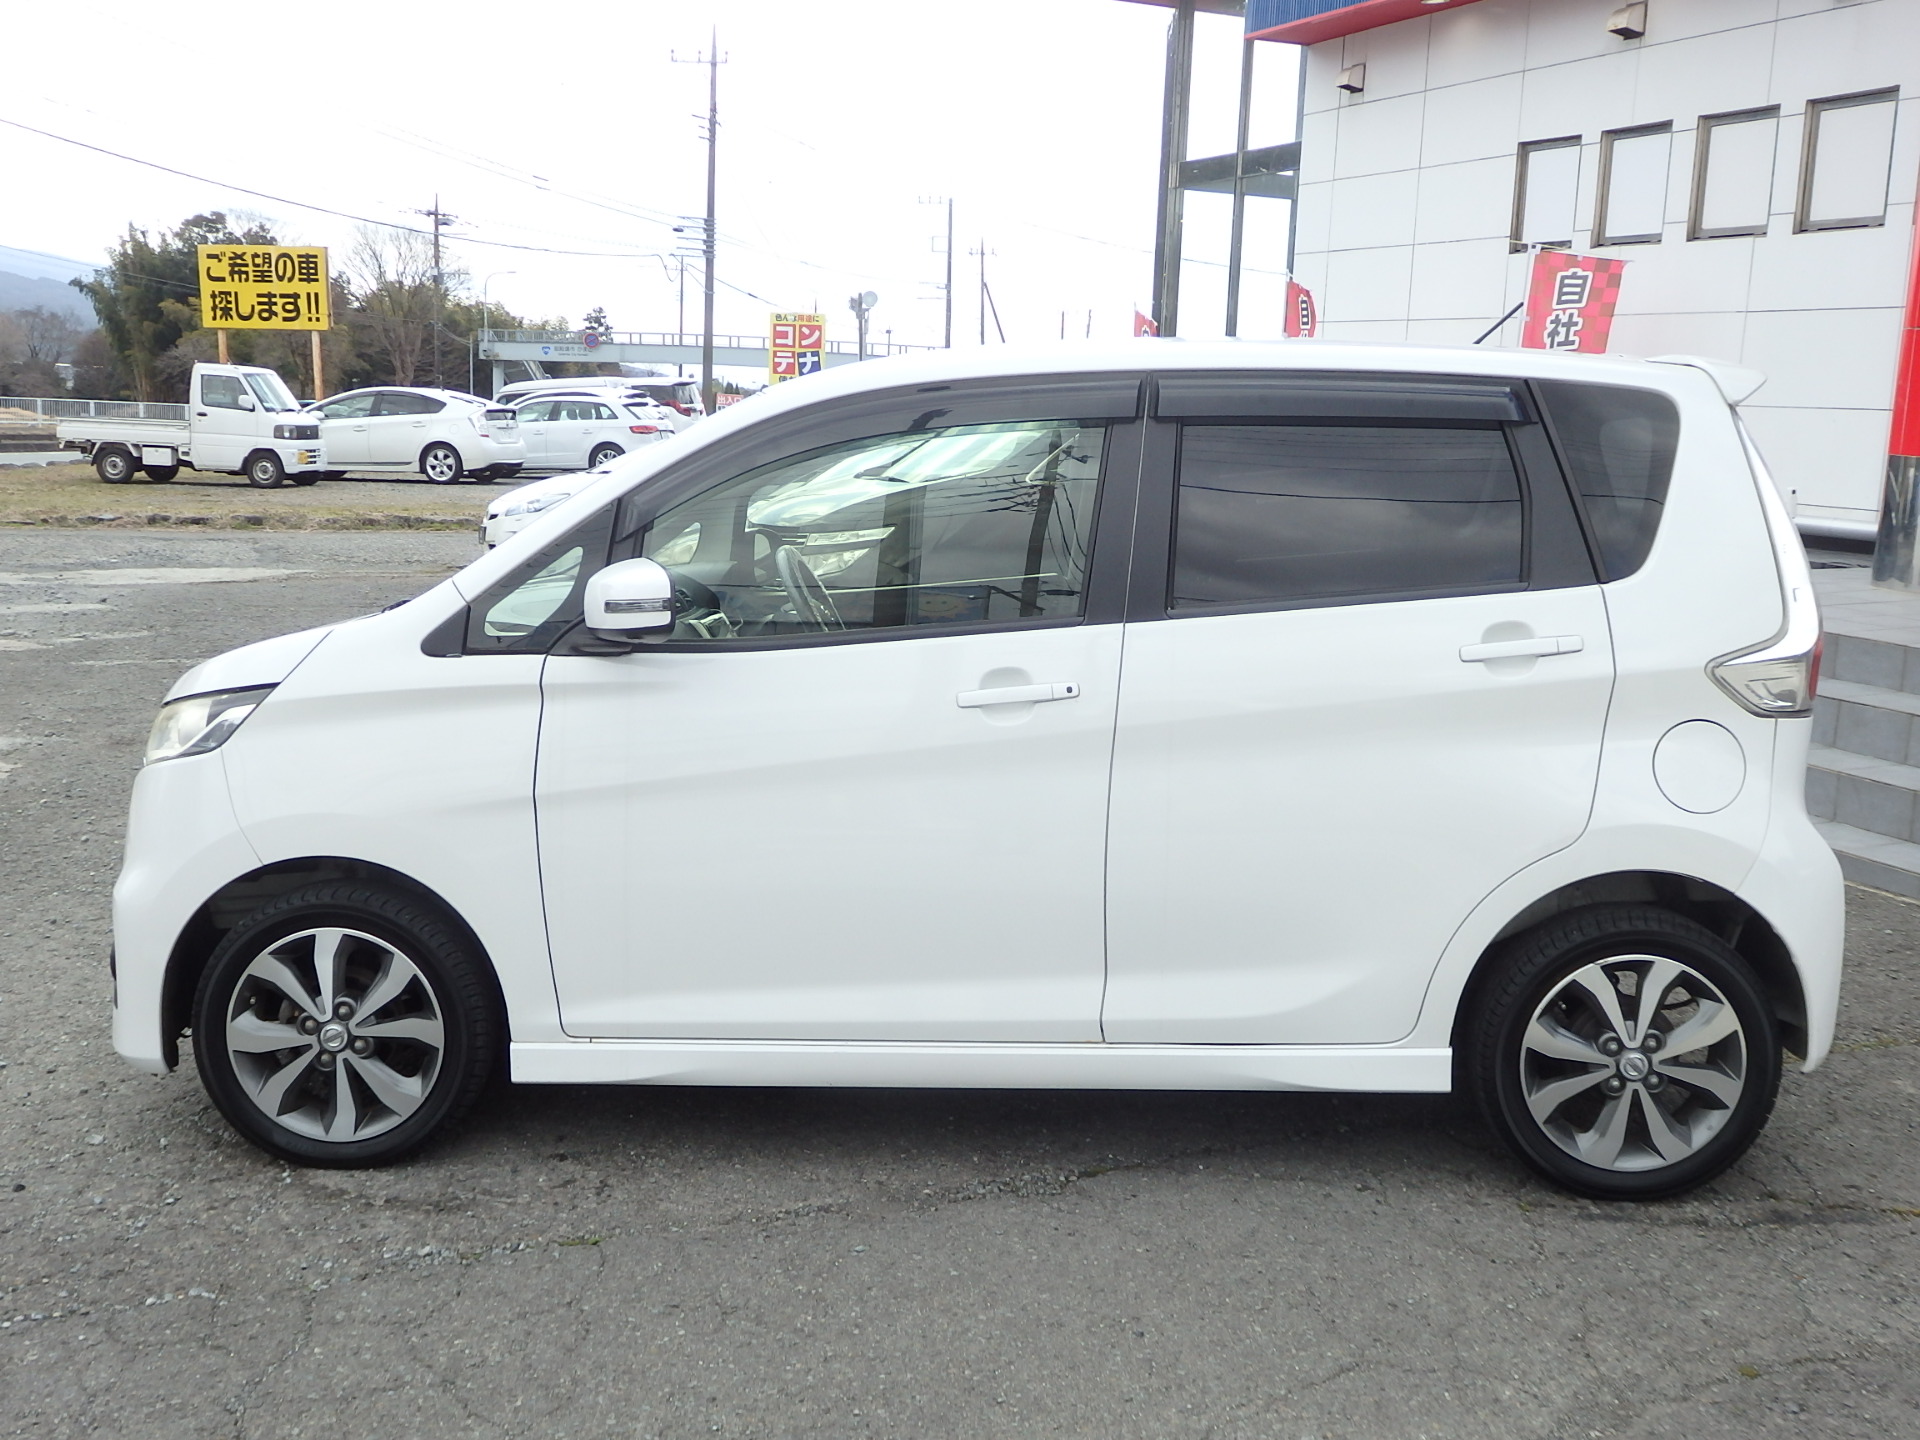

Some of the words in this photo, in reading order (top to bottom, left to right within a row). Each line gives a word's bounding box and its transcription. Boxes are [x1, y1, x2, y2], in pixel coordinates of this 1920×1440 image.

[206, 251, 320, 284] ご希望の車
[209, 290, 321, 322] 探します!!
[1299, 294, 1310, 337] 自
[1545, 270, 1591, 349] 自社
